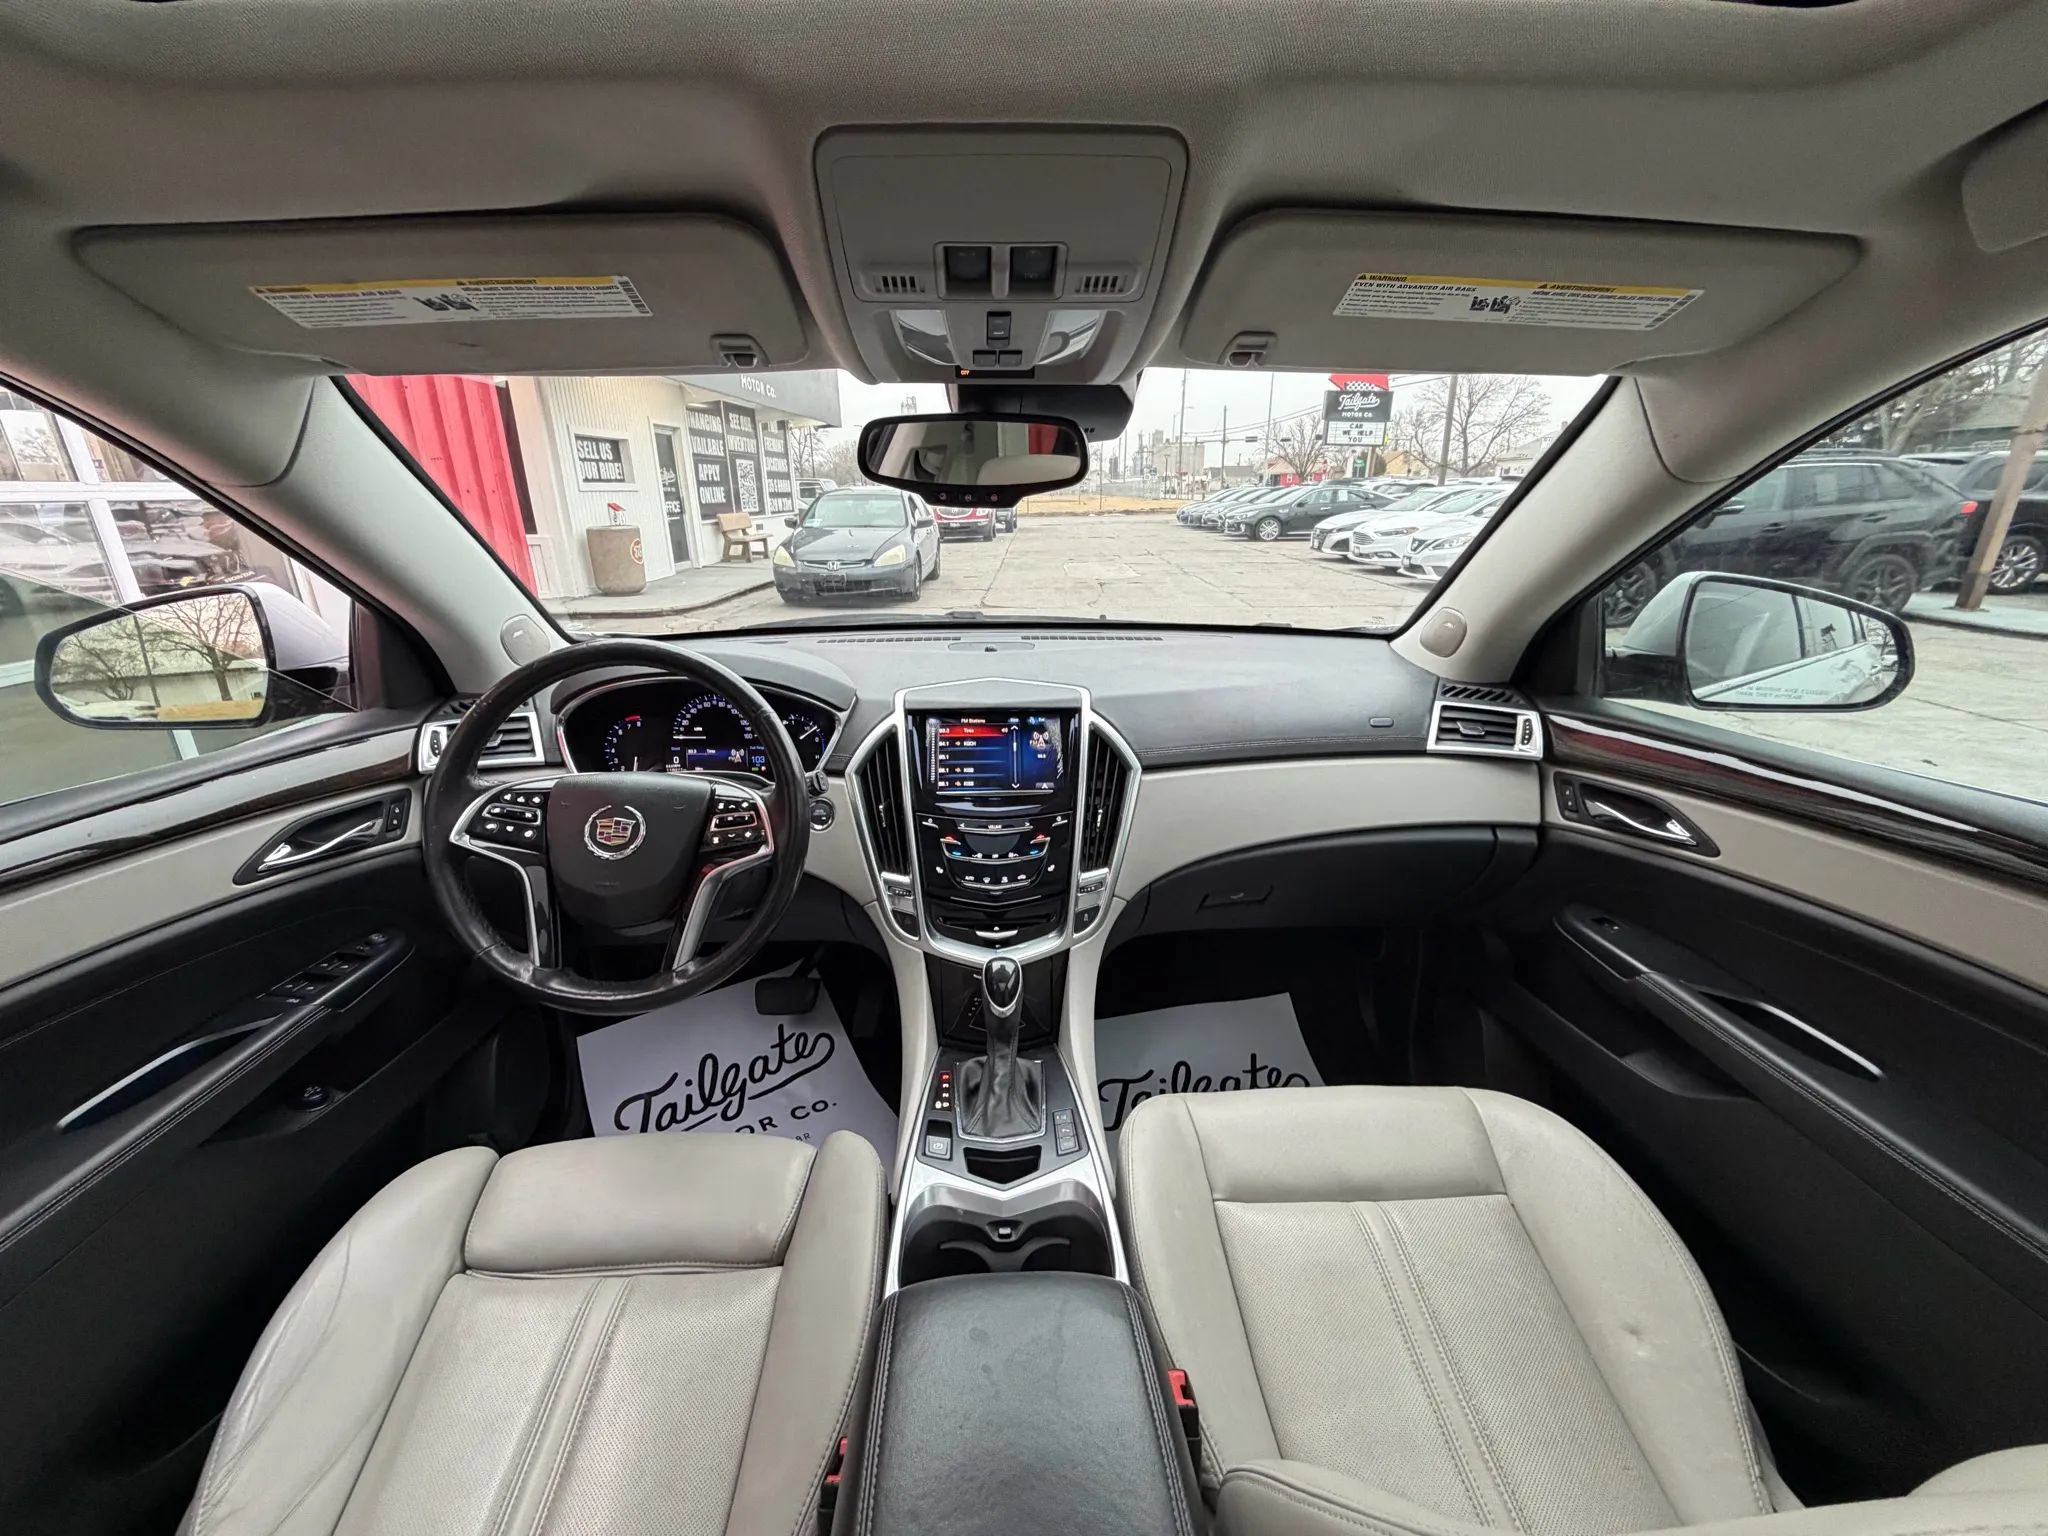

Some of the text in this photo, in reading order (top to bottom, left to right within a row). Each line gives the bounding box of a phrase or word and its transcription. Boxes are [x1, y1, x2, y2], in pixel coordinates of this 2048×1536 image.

[1369, 274, 1408, 283] WARNING
[1397, 283, 1438, 291] ADVANCED
[741, 375, 766, 396] MOTOR
[1338, 393, 1380, 411] Tailgate
[577, 440, 614, 460] SELL US
[691, 436, 726, 456] VAILABLE
[577, 461, 625, 480] OUR RIDE!
[698, 463, 720, 481] APPLY
[699, 486, 727, 504] ONLINE
[665, 501, 681, 513] FFICE
[673, 756, 680, 764] 0
[614, 1024, 836, 1133] Tailgate
[789, 1098, 838, 1121] CO.
